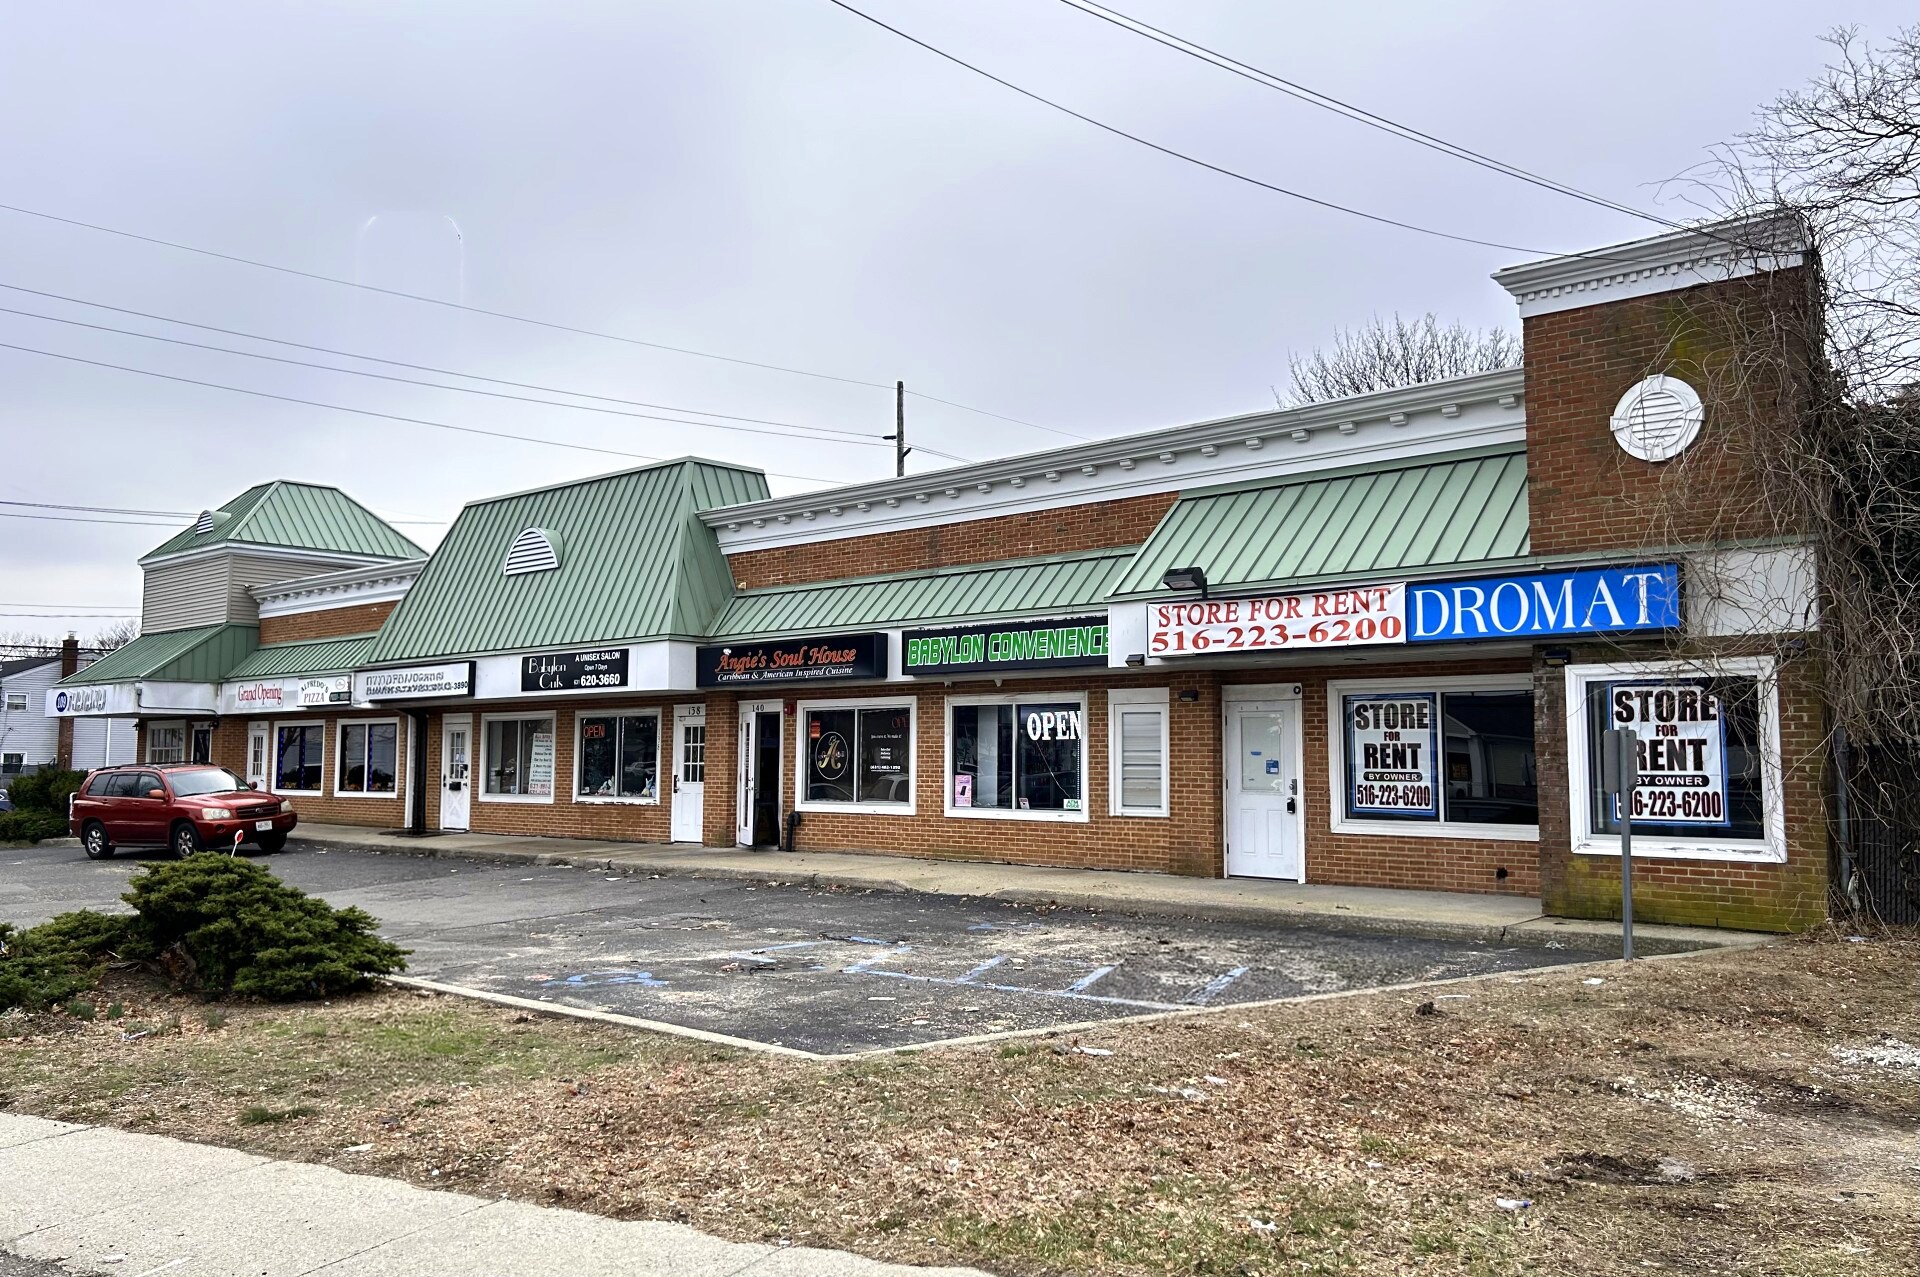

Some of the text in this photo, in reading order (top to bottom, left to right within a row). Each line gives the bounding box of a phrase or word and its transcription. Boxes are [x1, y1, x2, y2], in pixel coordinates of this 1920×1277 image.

[1158, 588, 1392, 628] STORE FOR RENT
[1152, 616, 1402, 652] 516-223-6200
[575, 651, 621, 662] A UNISEX SALON
[907, 634, 984, 667] BABYLON
[529, 656, 566, 676] Babylon
[597, 663, 608, 671] Days
[715, 645, 856, 674] Angie's Soul House
[580, 673, 620, 686] 620-3660
[717, 666, 853, 682] Caribbean & American Inspired Cuisine
[238, 683, 283, 706] Grand Opening
[301, 680, 329, 693] ALFREDO'S
[304, 692, 325, 703] PIZZA
[688, 706, 701, 715] 138
[752, 704, 764, 712] 140
[1615, 690, 1718, 723] STORE
[1354, 703, 1429, 730] STORE
[584, 725, 605, 738] OPEN
[1027, 710, 1081, 741] OPEN
[1655, 724, 1678, 737] FOR
[1384, 731, 1401, 742] FOR
[1364, 743, 1422, 769] RENT
[1636, 738, 1708, 771] RENT
[1384, 773, 1418, 781] OWNER
[1655, 777, 1703, 785] OWNER
[1357, 784, 1431, 807] 516-223-6200
